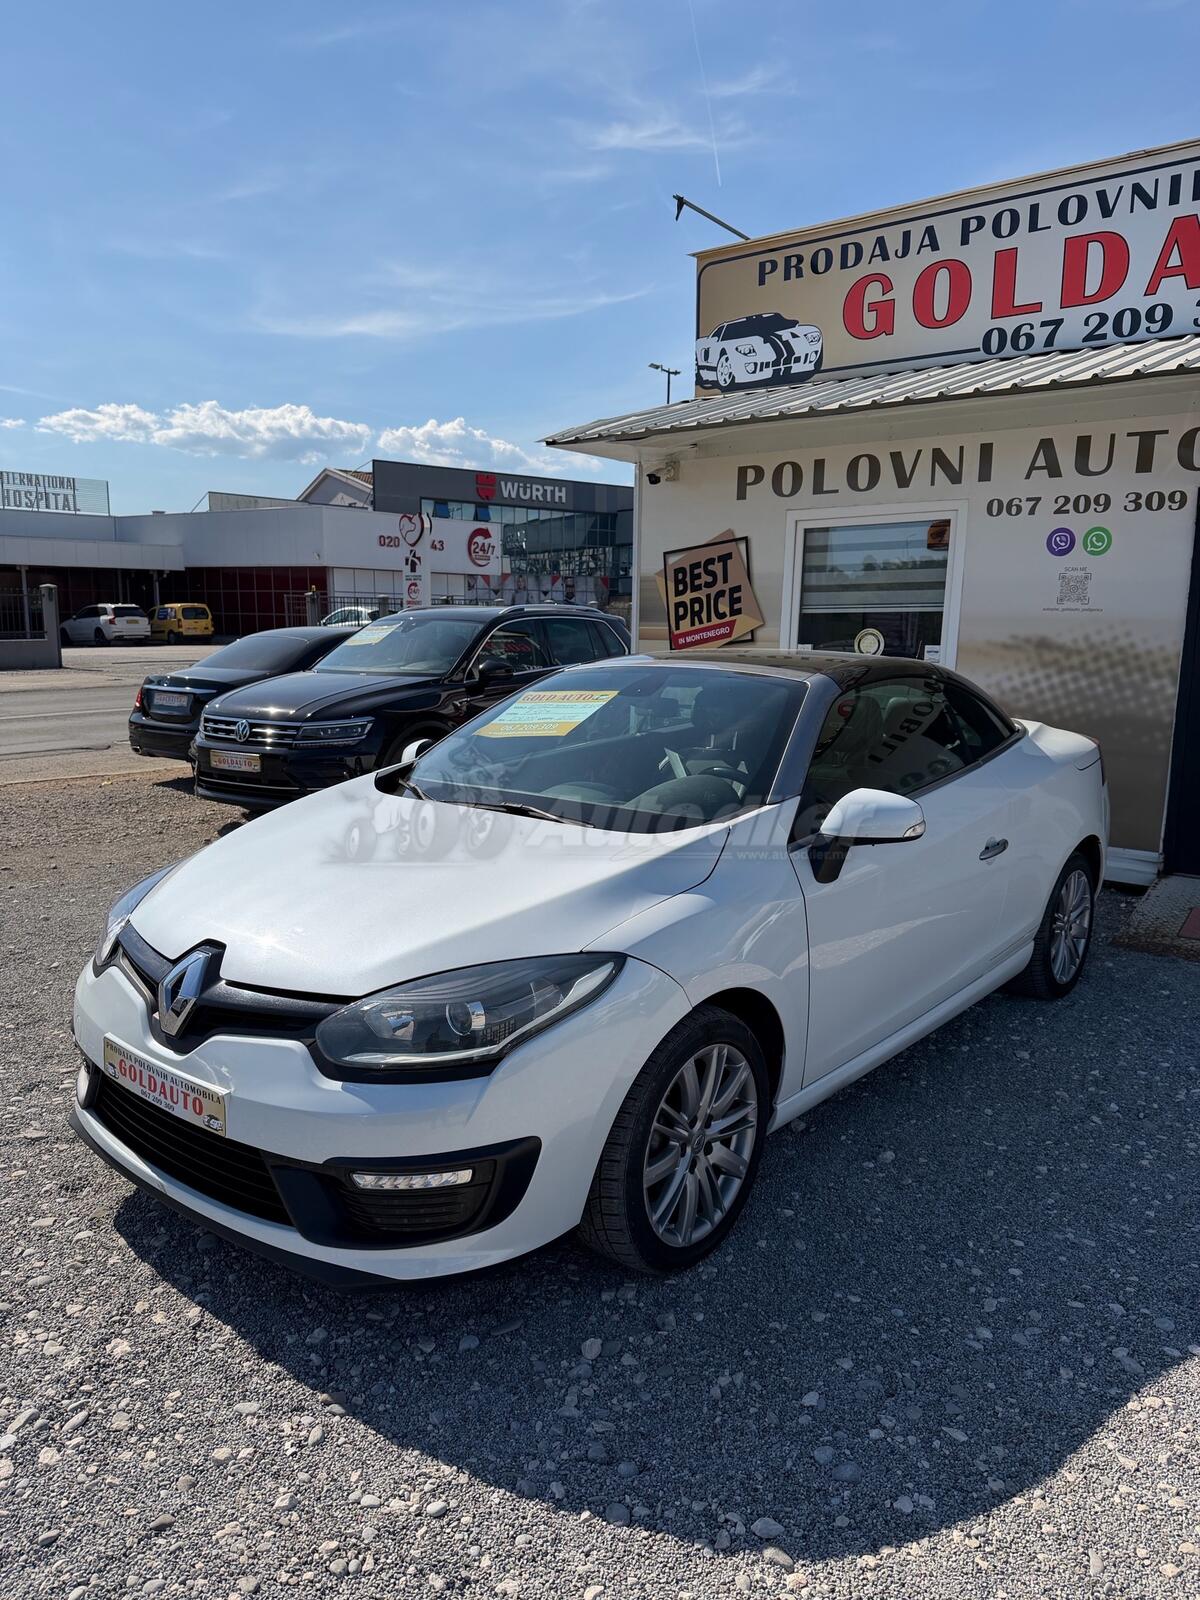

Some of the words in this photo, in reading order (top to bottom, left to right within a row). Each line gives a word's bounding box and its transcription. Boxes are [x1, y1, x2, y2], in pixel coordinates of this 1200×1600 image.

[758, 225, 940, 286] PRODAJA
[959, 170, 1200, 246] POLOVNI
[981, 318, 1064, 356] 067
[1081, 303, 1173, 343] 209
[500, 480, 567, 504] WÜRTH
[736, 442, 994, 501] POLOVNI
[2, 488, 80, 512] HOSPITAL
[986, 496, 1042, 517] 067
[1053, 493, 1112, 515] 209
[1123, 490, 1188, 512] 309
[379, 535, 400, 548] 020
[472, 541, 495, 555] 24/7
[673, 552, 733, 598] BEST
[674, 584, 742, 631] PRICE
[678, 637, 686, 645] IN
[686, 626, 730, 643] MONTENEGRO
[106, 1041, 133, 1063] PRODAJA
[134, 1057, 169, 1081] POLOVNIH
[169, 1076, 222, 1105] AUTOMOBILA
[118, 1059, 204, 1116] GOLDAUTO
